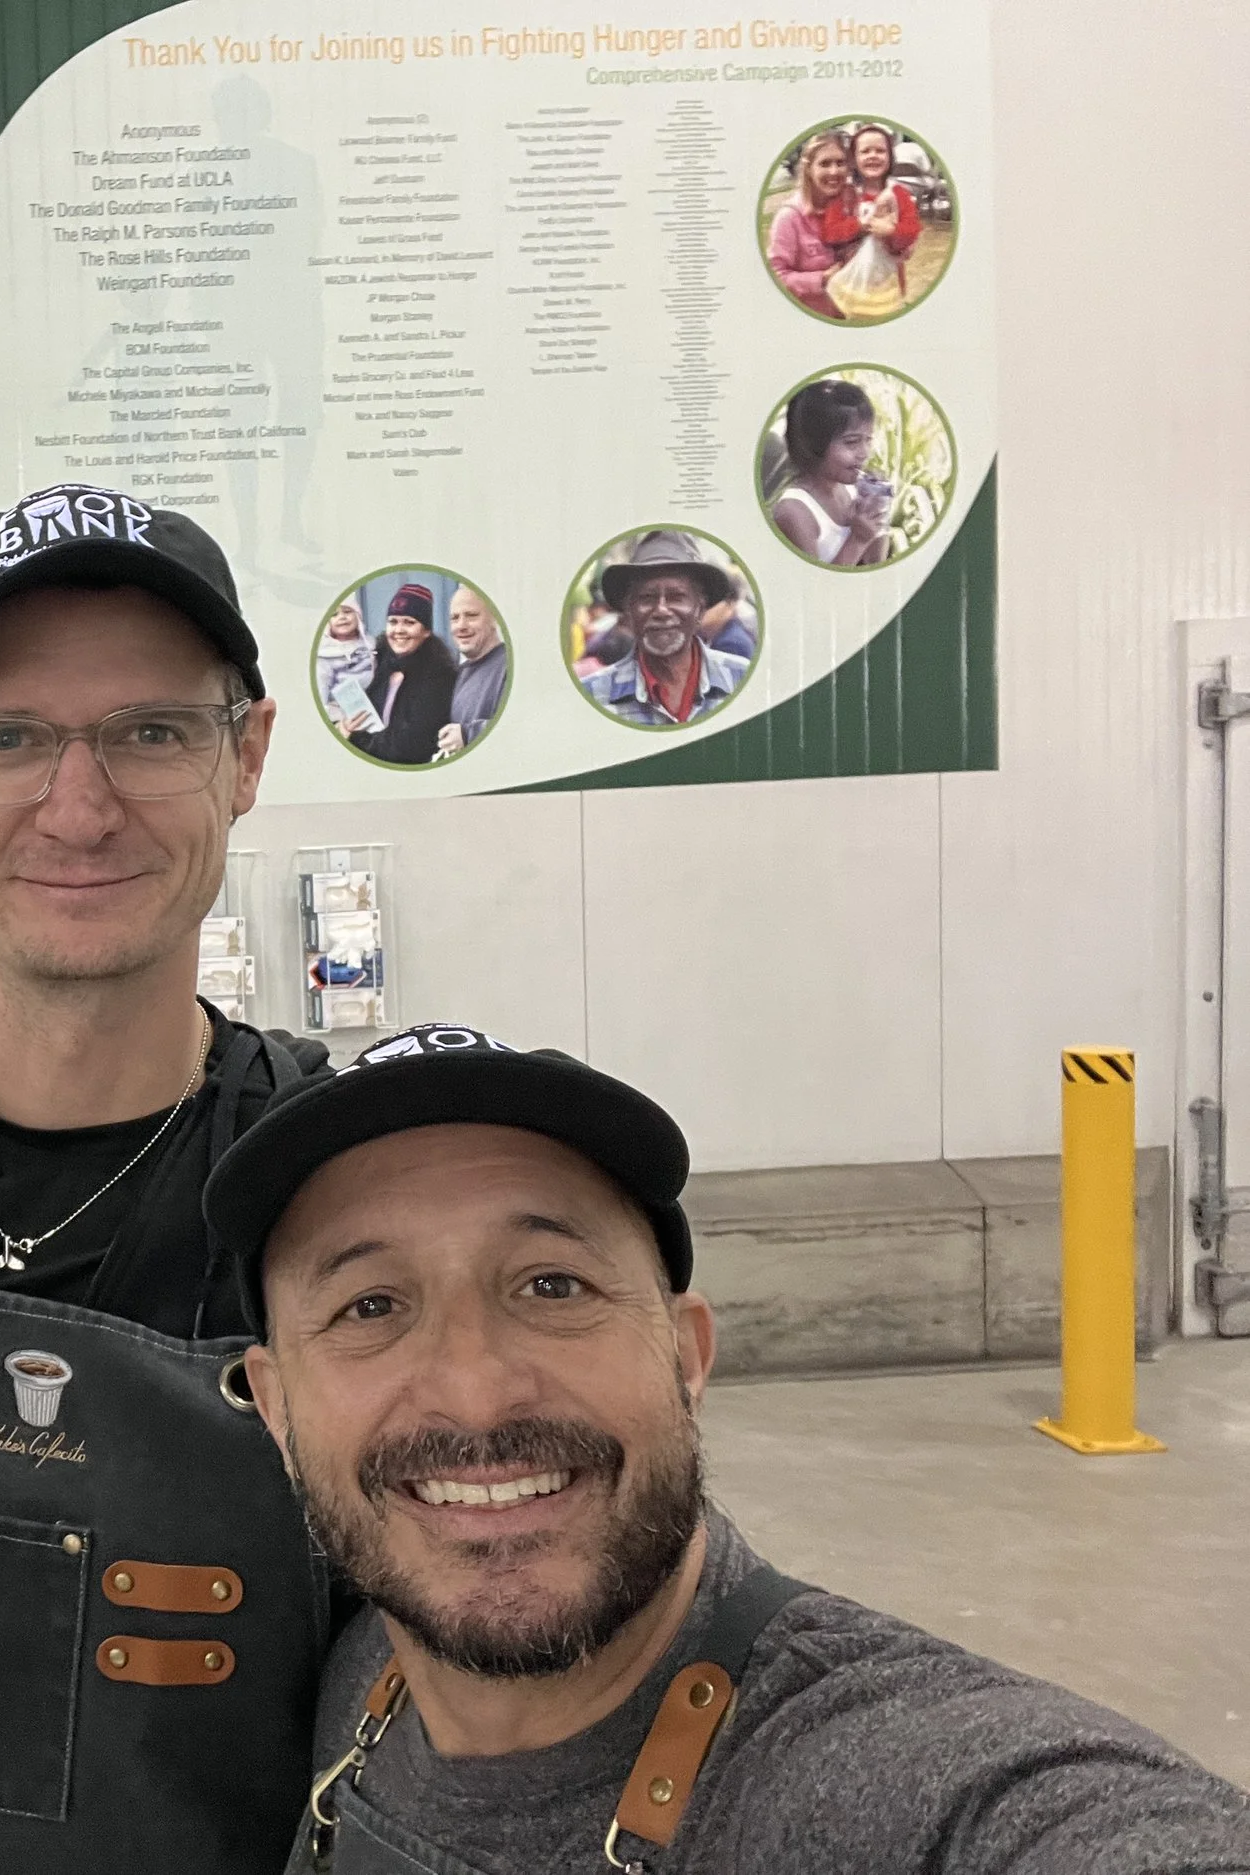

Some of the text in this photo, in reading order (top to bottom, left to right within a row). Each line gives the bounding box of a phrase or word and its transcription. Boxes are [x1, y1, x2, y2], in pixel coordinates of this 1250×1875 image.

[123, 19, 902, 67] Thank You for Joining us in Fighting Hunger and Giving Hope
[587, 60, 903, 85] Comprehensive Campaign 2011-2012
[121, 125, 201, 140] Anonymous
[73, 151, 98, 166] The
[176, 147, 250, 162] Foundation
[92, 172, 233, 191] Dream Fund at UCLA
[29, 196, 297, 217] The Donald Goodman Family Foundation
[54, 228, 78, 242] The
[82, 227, 120, 243] Ralph
[143, 225, 197, 239] Parsons
[201, 222, 274, 236] Foundation
[79, 247, 250, 266] The Rose Hills Foundation
[97, 273, 234, 293] Weingart Foundation
[111, 323, 130, 334] The
[82, 367, 101, 380] The
[104, 367, 139, 379] Capital
[165, 387, 183, 398] and
[109, 411, 128, 421] The
[132, 431, 142, 443] of
[144, 431, 188, 442] Northern
[191, 429, 216, 440] Trust
[218, 428, 243, 439] Bank
[247, 426, 257, 438] of
[259, 426, 306, 437] California
[64, 456, 82, 467] The
[85, 456, 112, 466] Louis
[115, 454, 134, 465] and
[157, 473, 213, 484] Foundation
[28, 1431, 86, 1468] Cafecito
